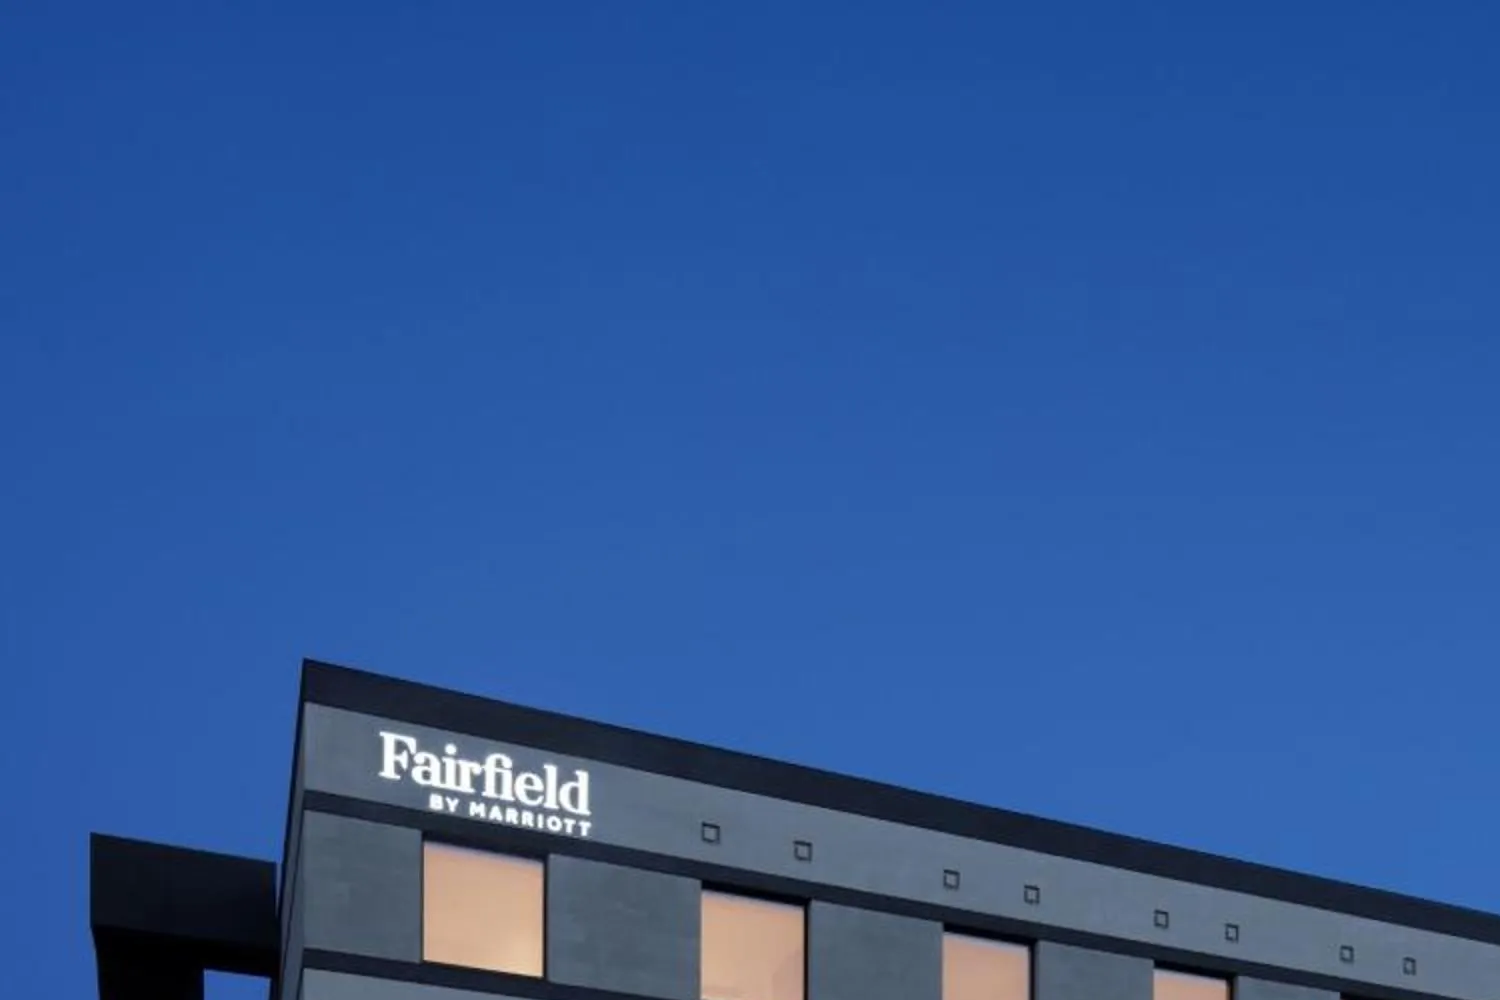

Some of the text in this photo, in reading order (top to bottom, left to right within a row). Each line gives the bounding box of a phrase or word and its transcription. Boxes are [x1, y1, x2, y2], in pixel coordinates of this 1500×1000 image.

[378, 731, 592, 816] Fairfield
[429, 793, 592, 837] BY MARRIOTT
